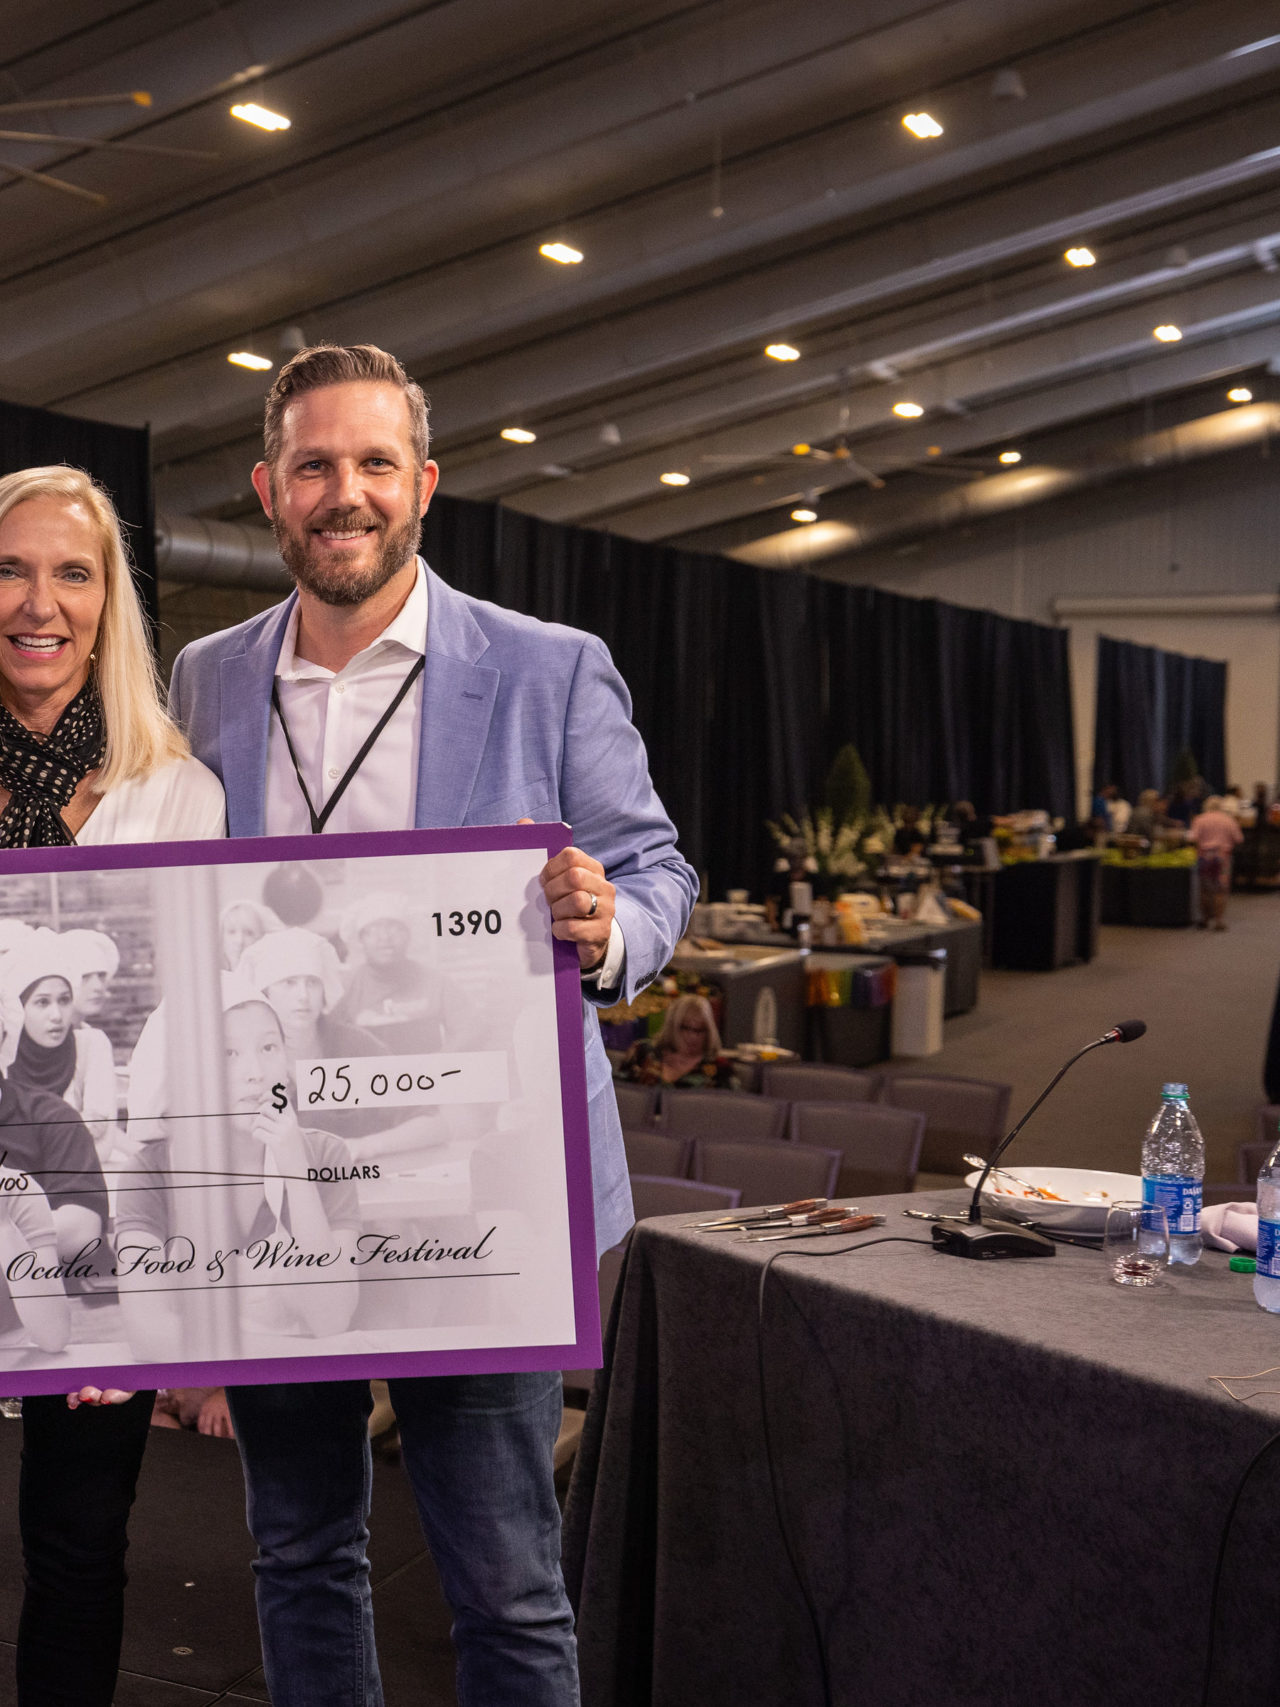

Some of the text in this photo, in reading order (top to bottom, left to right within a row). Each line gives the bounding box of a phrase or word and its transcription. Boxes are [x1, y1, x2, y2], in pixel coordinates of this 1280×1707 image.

[431, 909, 502, 937] 1390
[271, 1082, 288, 1114] $
[307, 1164, 381, 1182] DOLLARS
[6, 1226, 497, 1283] Ocala Food & Wine Festival
